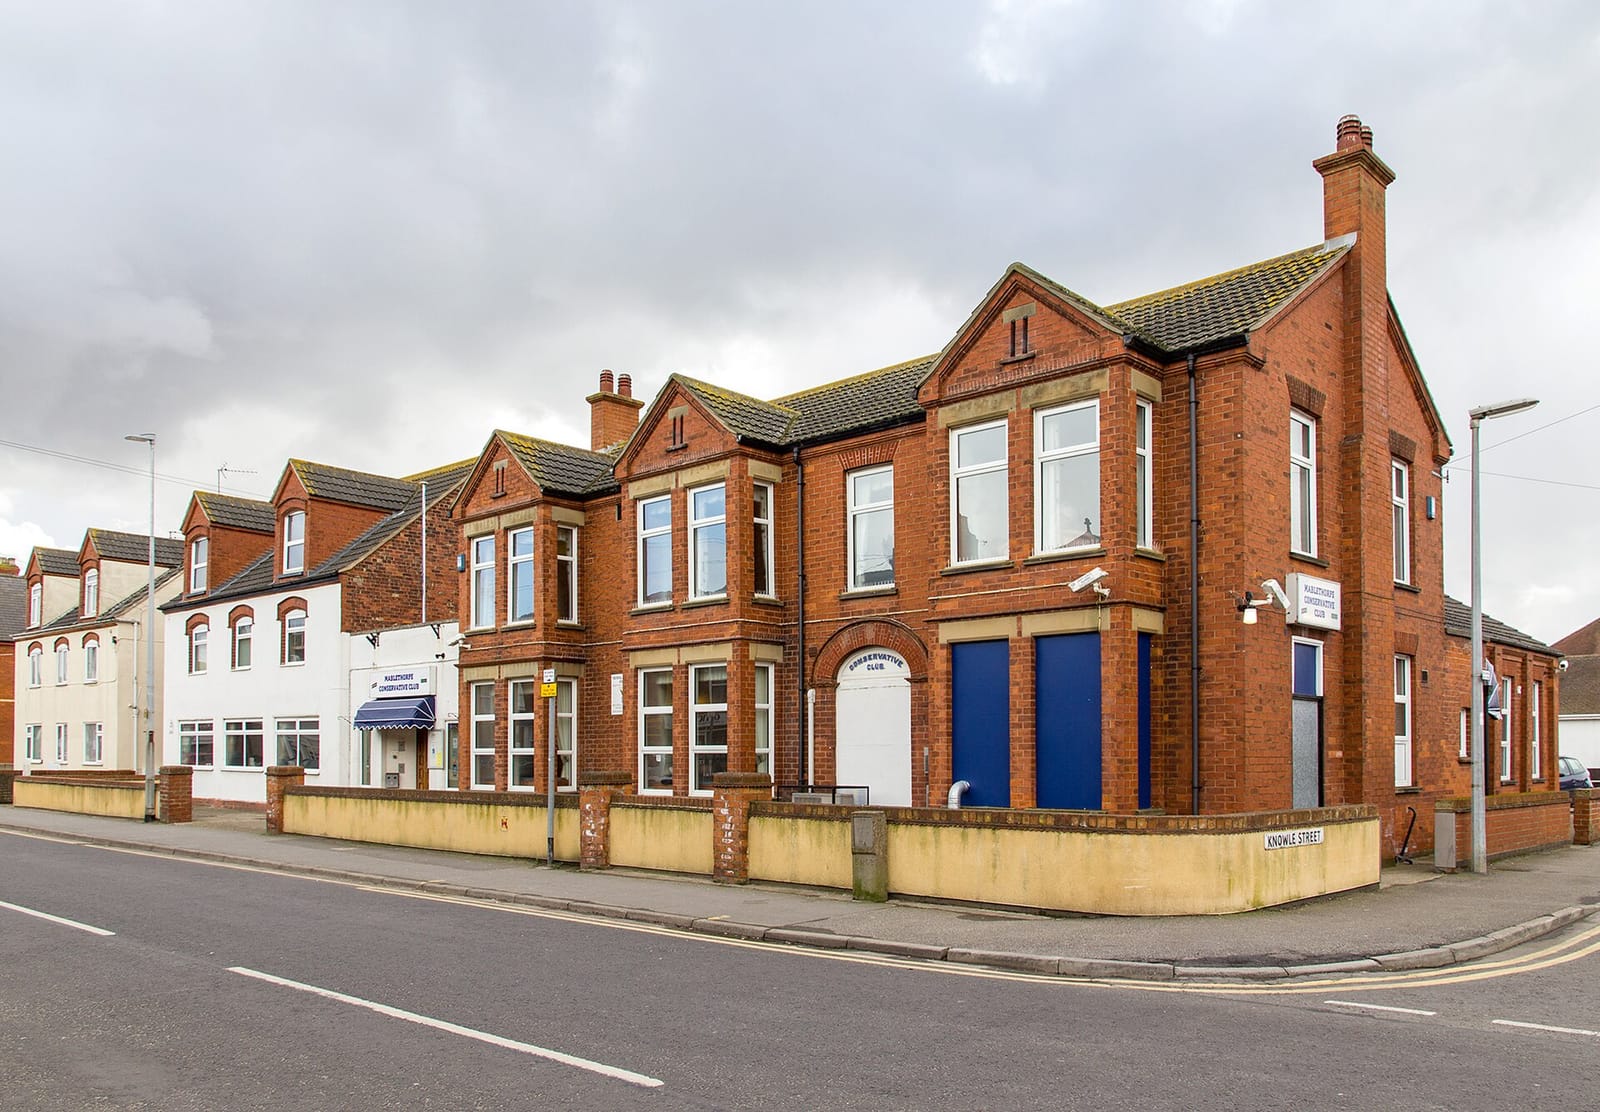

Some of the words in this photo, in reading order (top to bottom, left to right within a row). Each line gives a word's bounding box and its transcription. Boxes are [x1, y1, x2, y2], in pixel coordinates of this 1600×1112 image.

[1304, 584, 1335, 599] MABLETHORPE
[1304, 595, 1335, 610] CONSERVATIVE
[1314, 609, 1325, 619] CLUB
[849, 653, 904, 671] CONSERVATIVE
[384, 673, 414, 682] MABLETHORPE
[378, 683, 408, 692] CONSERVATIVE
[1267, 833, 1296, 848] KNOWLE
[1298, 830, 1321, 844] STREET
